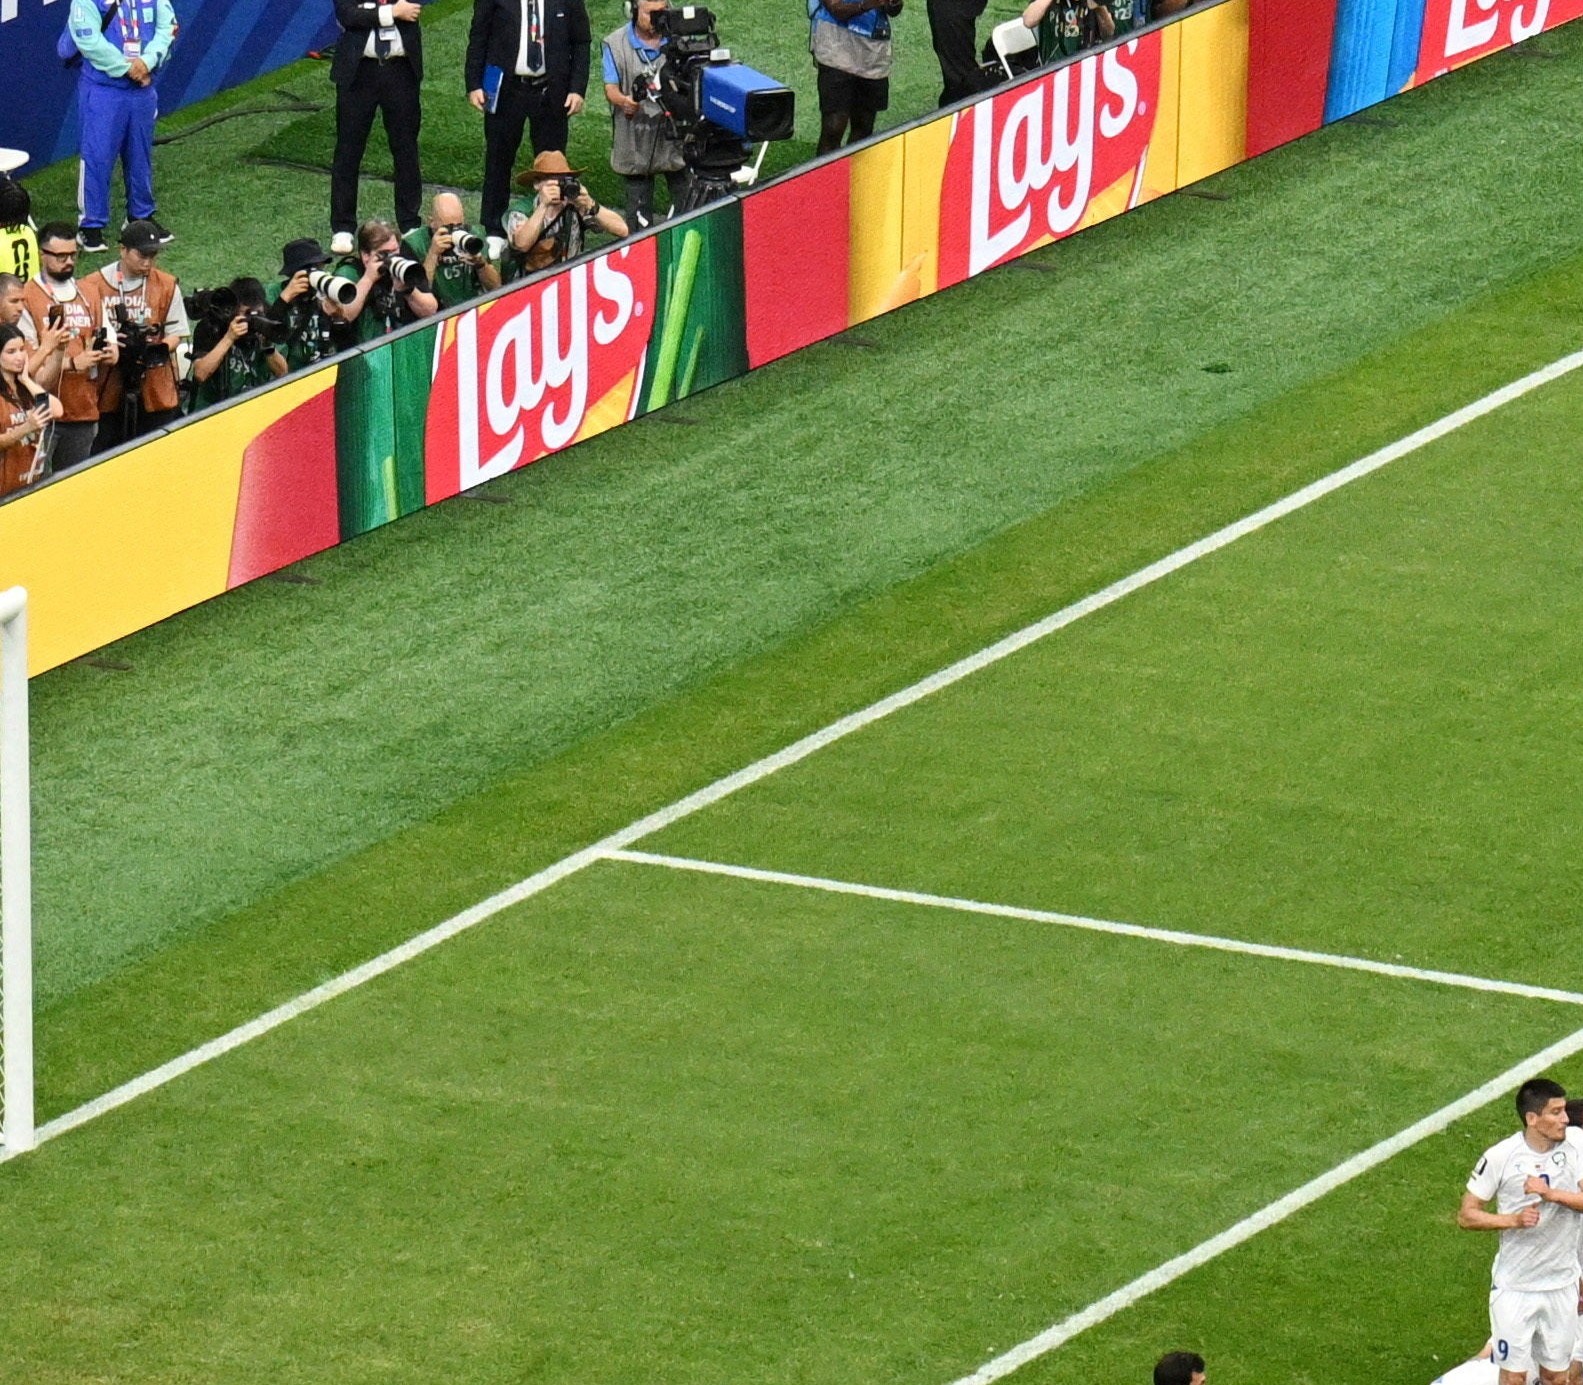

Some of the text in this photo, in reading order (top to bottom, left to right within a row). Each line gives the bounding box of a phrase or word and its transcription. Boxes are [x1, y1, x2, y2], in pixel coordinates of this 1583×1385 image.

[968, 36, 1138, 256] Lay's
[457, 244, 633, 491] Lay's
[1498, 1339, 1509, 1361] 9
